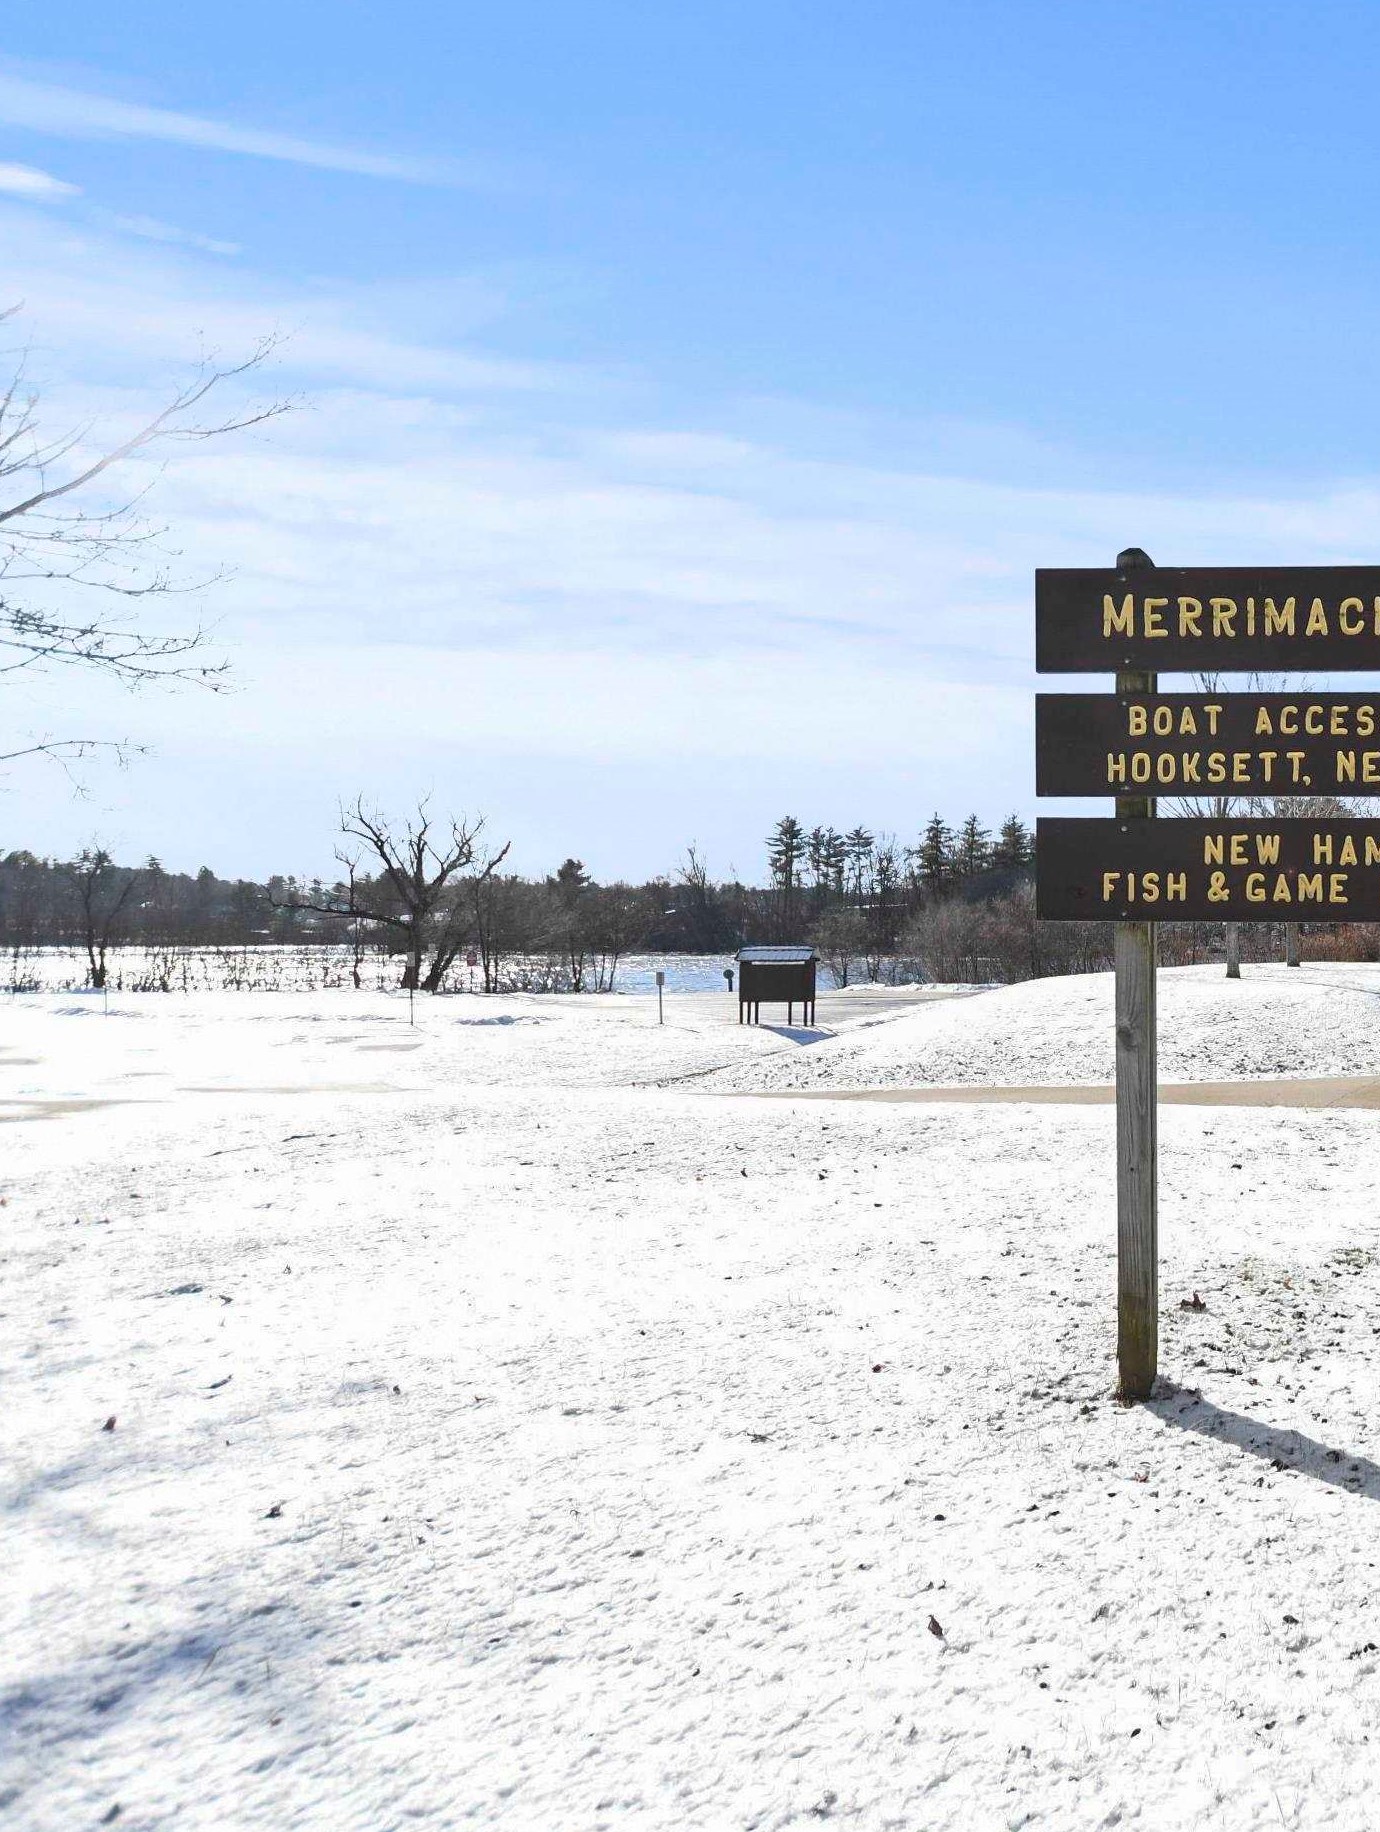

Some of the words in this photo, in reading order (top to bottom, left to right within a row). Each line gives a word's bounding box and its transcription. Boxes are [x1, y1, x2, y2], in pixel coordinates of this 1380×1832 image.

[1128, 705, 1223, 736] BOAT
[1106, 752, 1312, 787] HOOKSETT,
[1203, 834, 1281, 866] NEW
[1102, 872, 1188, 903] FISH
[1206, 870, 1231, 903] &
[1244, 872, 1349, 904] GAME
